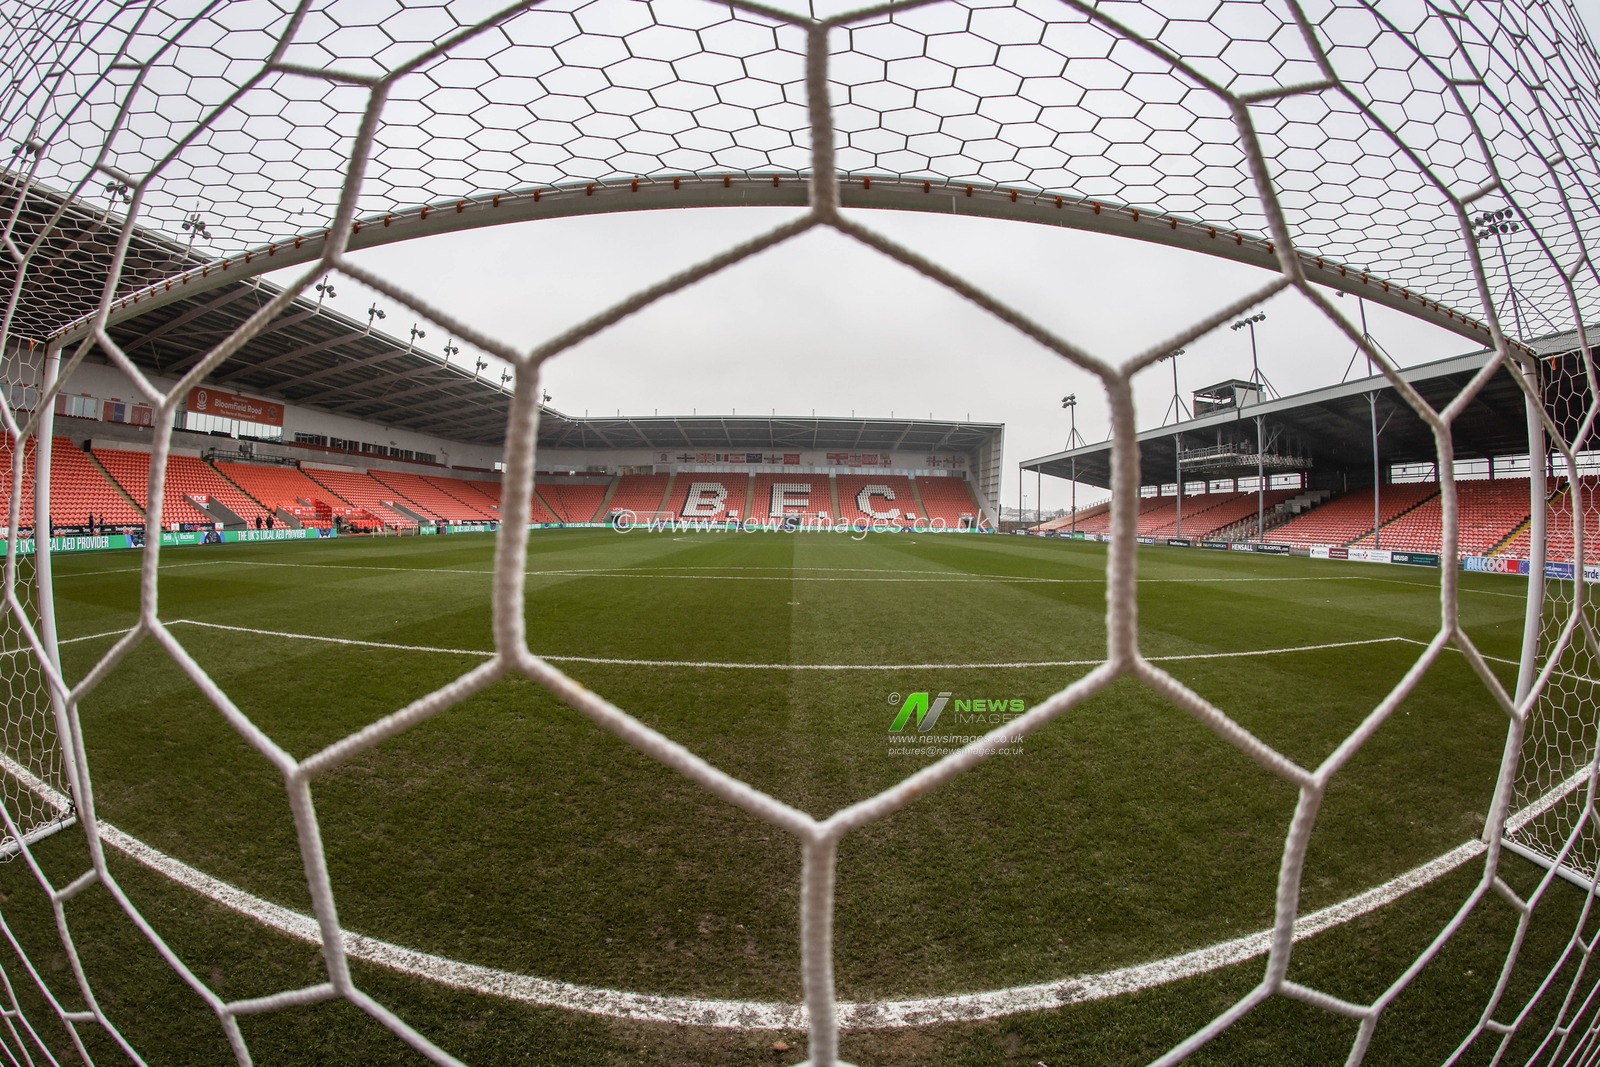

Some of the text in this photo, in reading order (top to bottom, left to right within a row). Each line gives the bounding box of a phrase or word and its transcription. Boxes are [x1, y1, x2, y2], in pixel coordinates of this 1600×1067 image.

[214, 398, 247, 412] Bloomfield
[247, 405, 263, 415] Road
[238, 529, 306, 541] THE UK'S LOCAL AED PROVIDER
[62, 537, 75, 551] AED
[77, 536, 109, 549] PROVIDER
[1231, 543, 1253, 551] HENSALL
